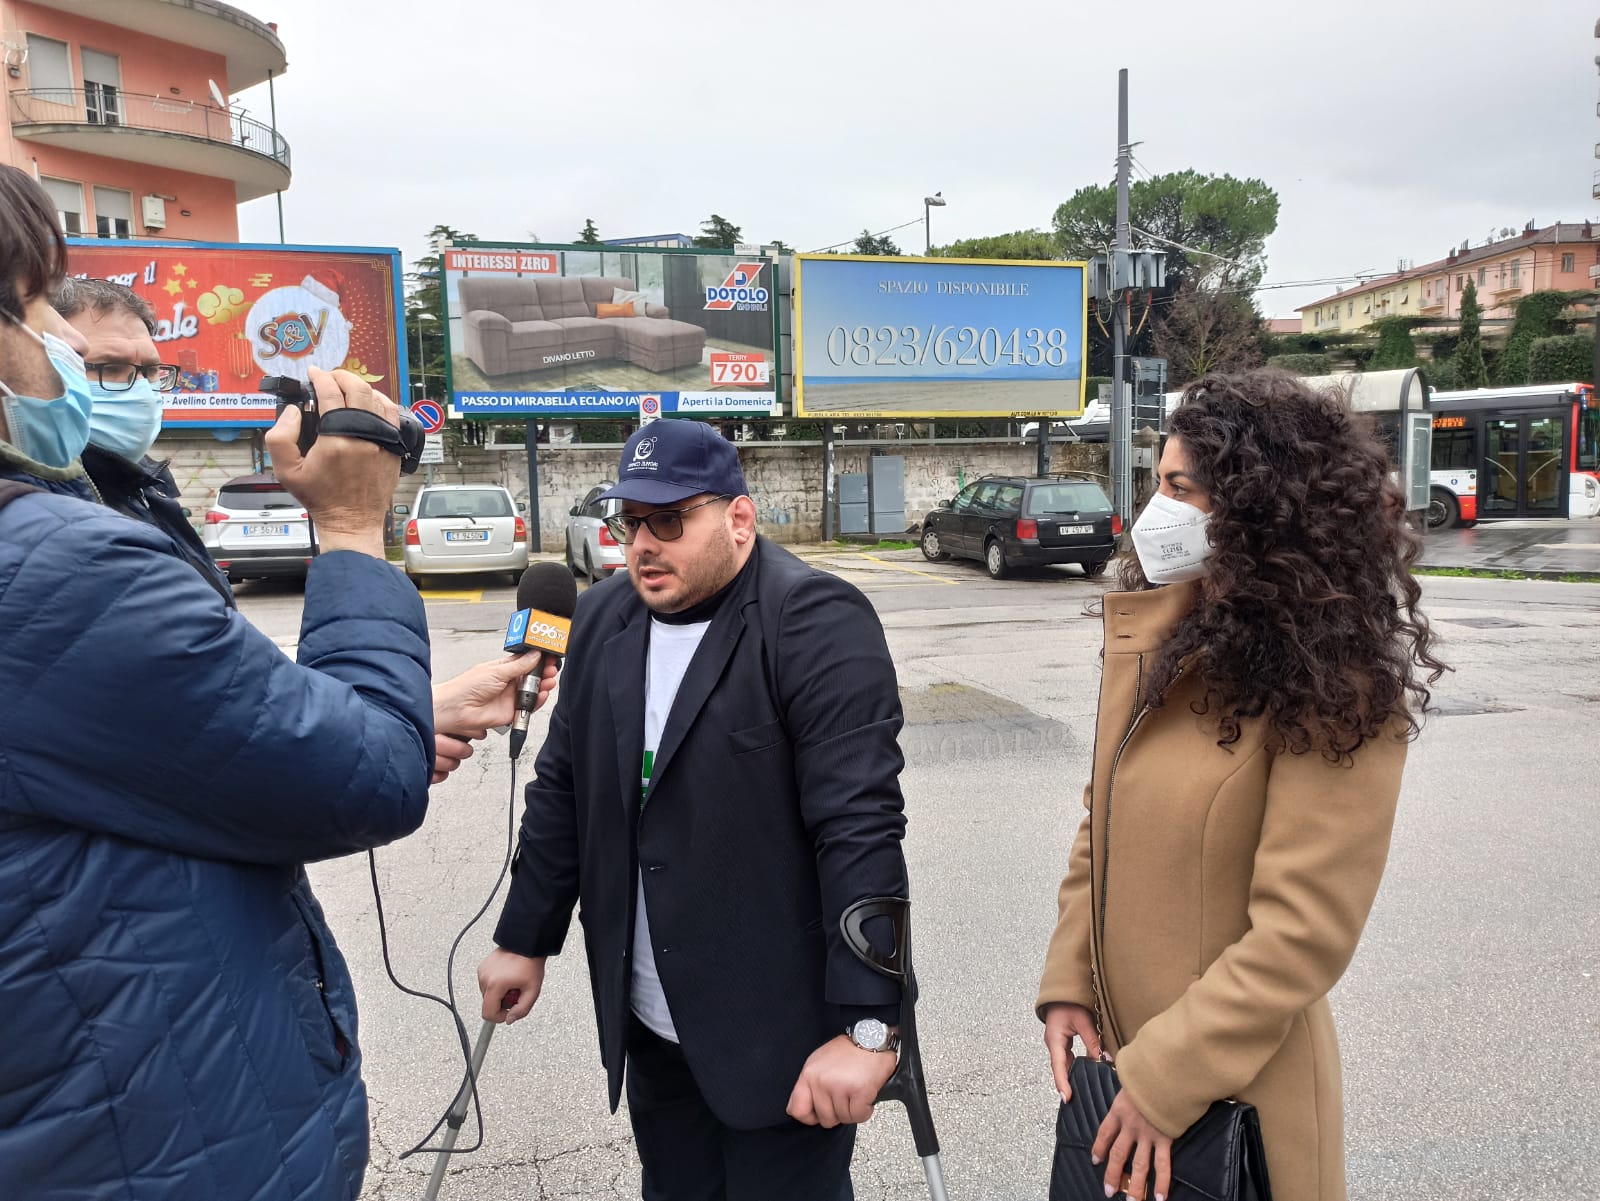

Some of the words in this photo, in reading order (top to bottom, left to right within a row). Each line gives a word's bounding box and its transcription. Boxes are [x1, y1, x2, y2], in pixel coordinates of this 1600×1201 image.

[452, 254, 517, 270] INTERESSI
[520, 256, 550, 271] ZERO
[144, 260, 156, 285] il
[707, 287, 768, 303] DOTOLO
[878, 280, 929, 295] SPAZIO
[937, 281, 1029, 297] DISPONIBILE
[152, 301, 198, 342] ale
[827, 323, 1068, 367] 0823/620438
[542, 353, 571, 364] DIVANO
[571, 350, 596, 360] LETTO
[172, 396, 207, 406] Avellino
[209, 396, 239, 406] Centro
[241, 396, 277, 406] Commer
[461, 396, 499, 406] PASSO
[500, 396, 513, 406] DI
[515, 396, 578, 406] MIRABELLA
[580, 396, 624, 406] ECLANO
[682, 397, 713, 407] Aperti
[714, 397, 723, 406] la
[725, 397, 772, 406] Domenica
